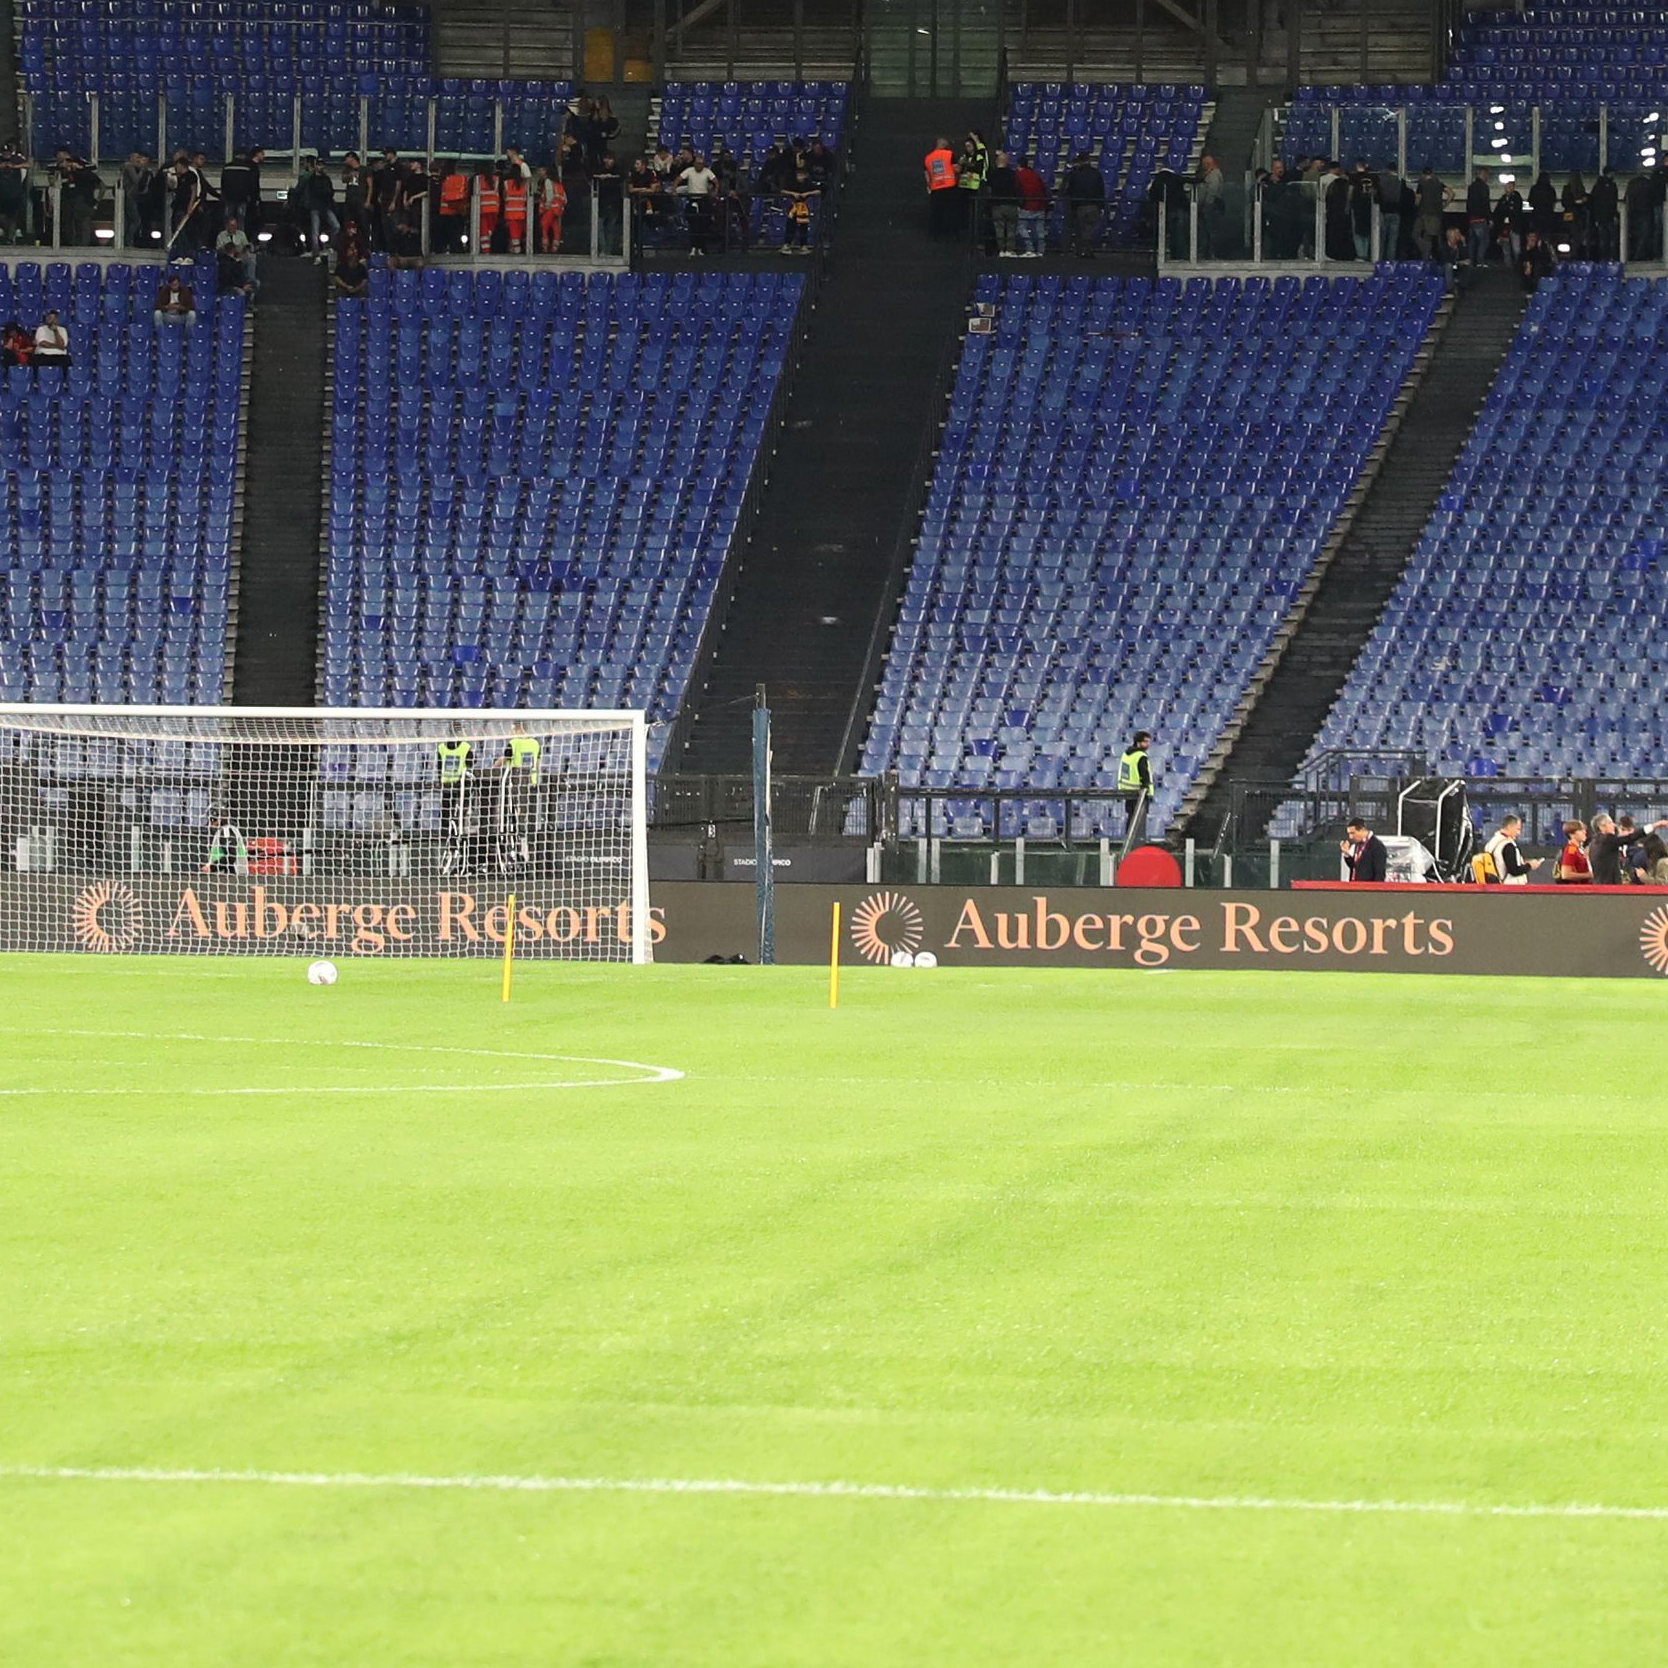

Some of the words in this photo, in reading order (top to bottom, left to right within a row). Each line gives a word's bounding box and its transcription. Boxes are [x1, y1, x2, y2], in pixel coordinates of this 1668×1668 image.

[167, 887, 417, 954] Auberge
[437, 891, 668, 945] Resorts
[944, 896, 1202, 966] Auberge
[1220, 902, 1456, 956] Resorts
